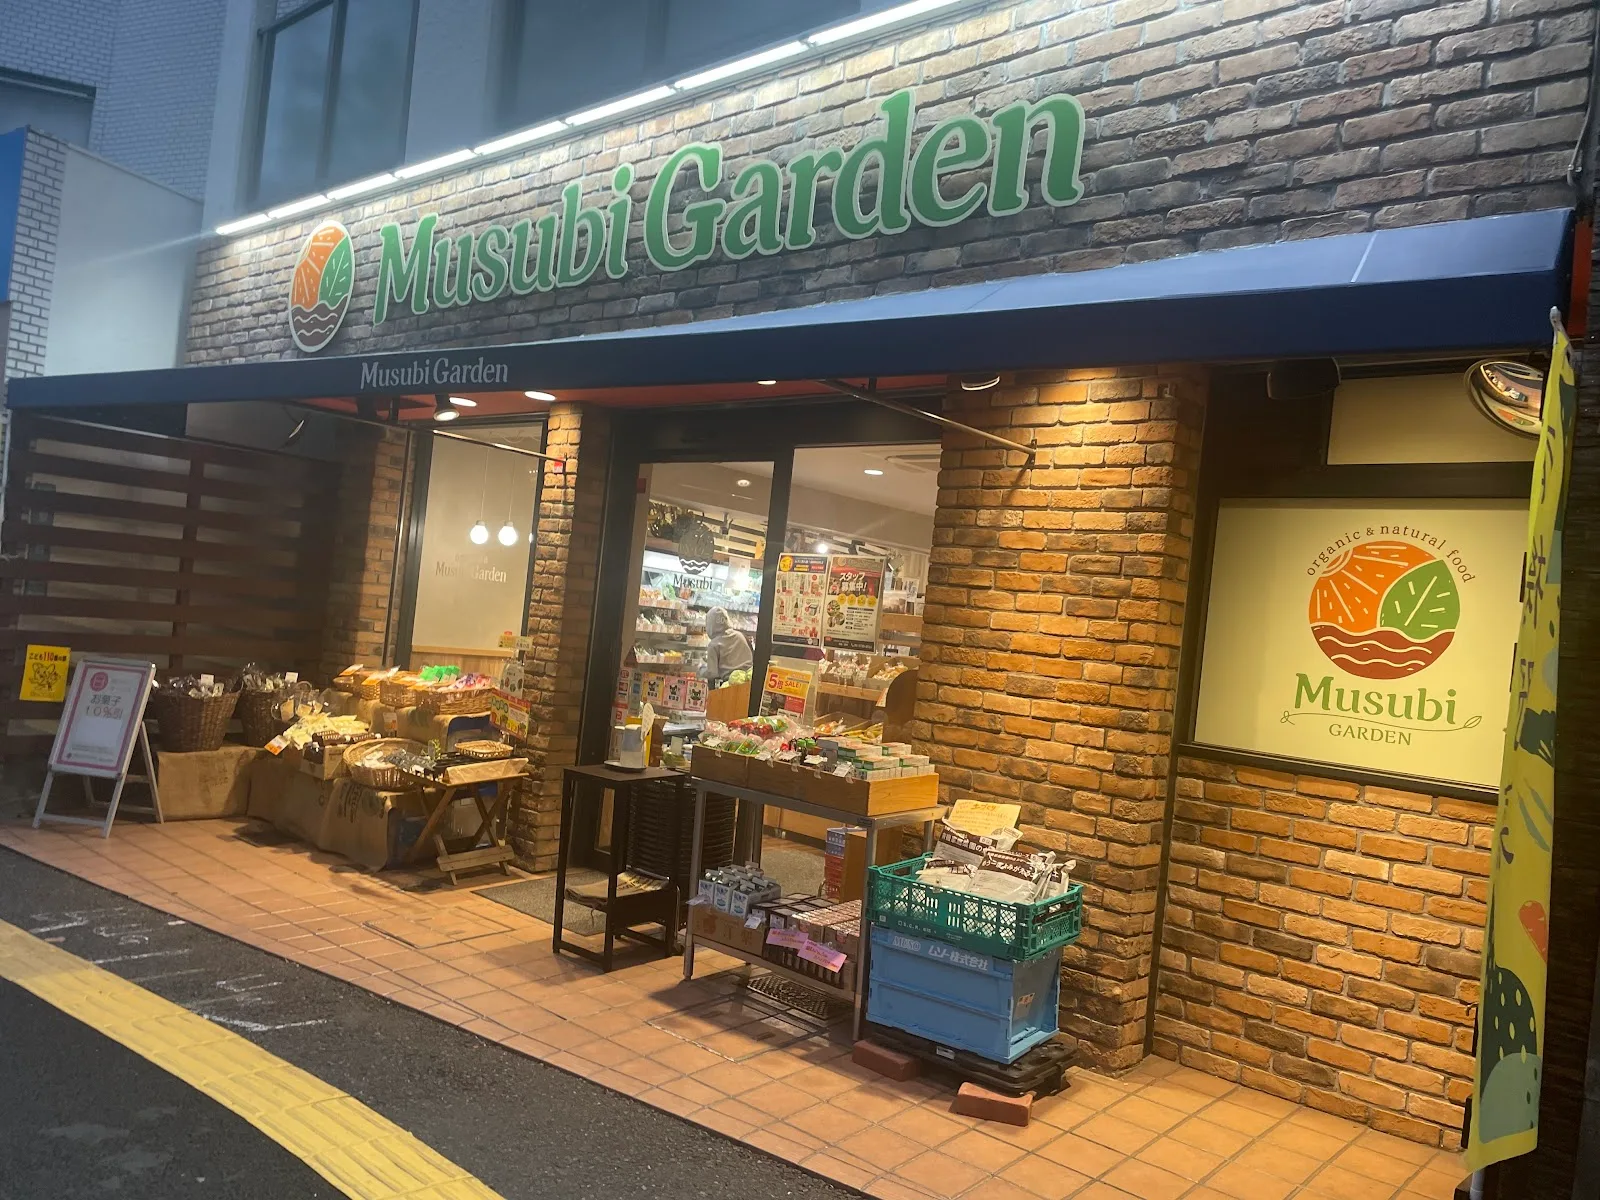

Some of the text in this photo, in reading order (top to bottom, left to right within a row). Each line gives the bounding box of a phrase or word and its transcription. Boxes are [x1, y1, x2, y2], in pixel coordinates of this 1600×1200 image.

[371, 87, 1086, 327] Musubi Garden
[360, 357, 508, 389] Musubi Garden
[1306, 525, 1476, 583] organic & natural food
[839, 572, 866, 581] スタッフ
[90, 694, 122, 707] お菓子
[1294, 672, 1456, 725] Musubi
[1328, 723, 1412, 746] GARDEN
[928, 944, 989, 971] ムソー株式会社
